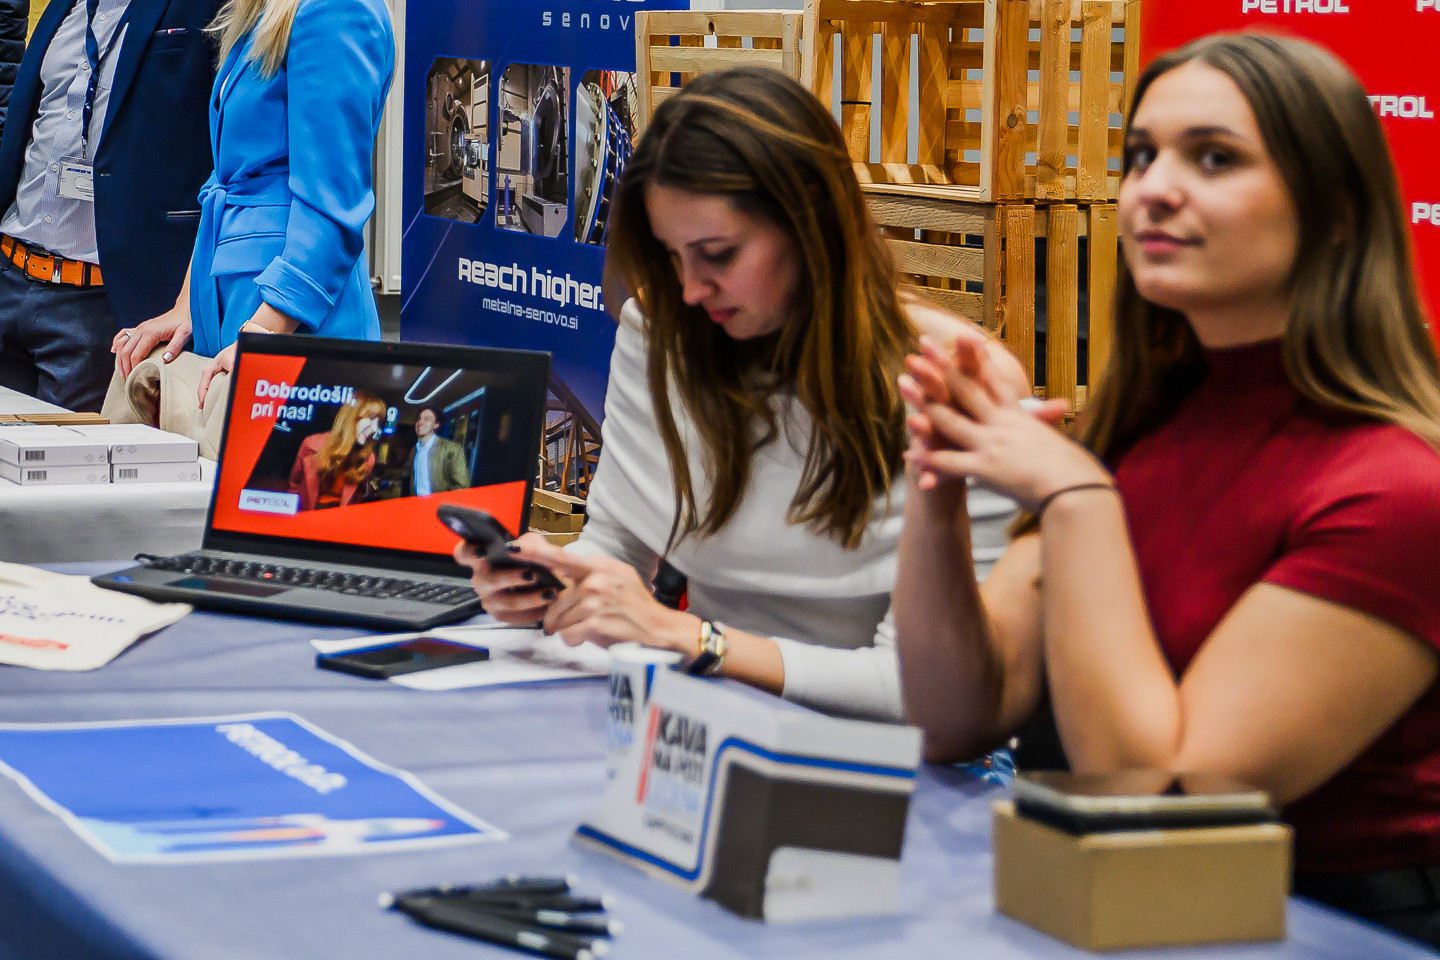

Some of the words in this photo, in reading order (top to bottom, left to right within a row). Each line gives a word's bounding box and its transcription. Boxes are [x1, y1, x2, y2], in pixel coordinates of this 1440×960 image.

[542, 9, 630, 31] senov
[1366, 95, 1434, 119] TROL
[458, 257, 527, 295] Reach
[531, 266, 605, 312] higher.
[482, 296, 579, 330] metalna-senovo.si
[251, 401, 274, 420] pri
[276, 403, 314, 421] nas!
